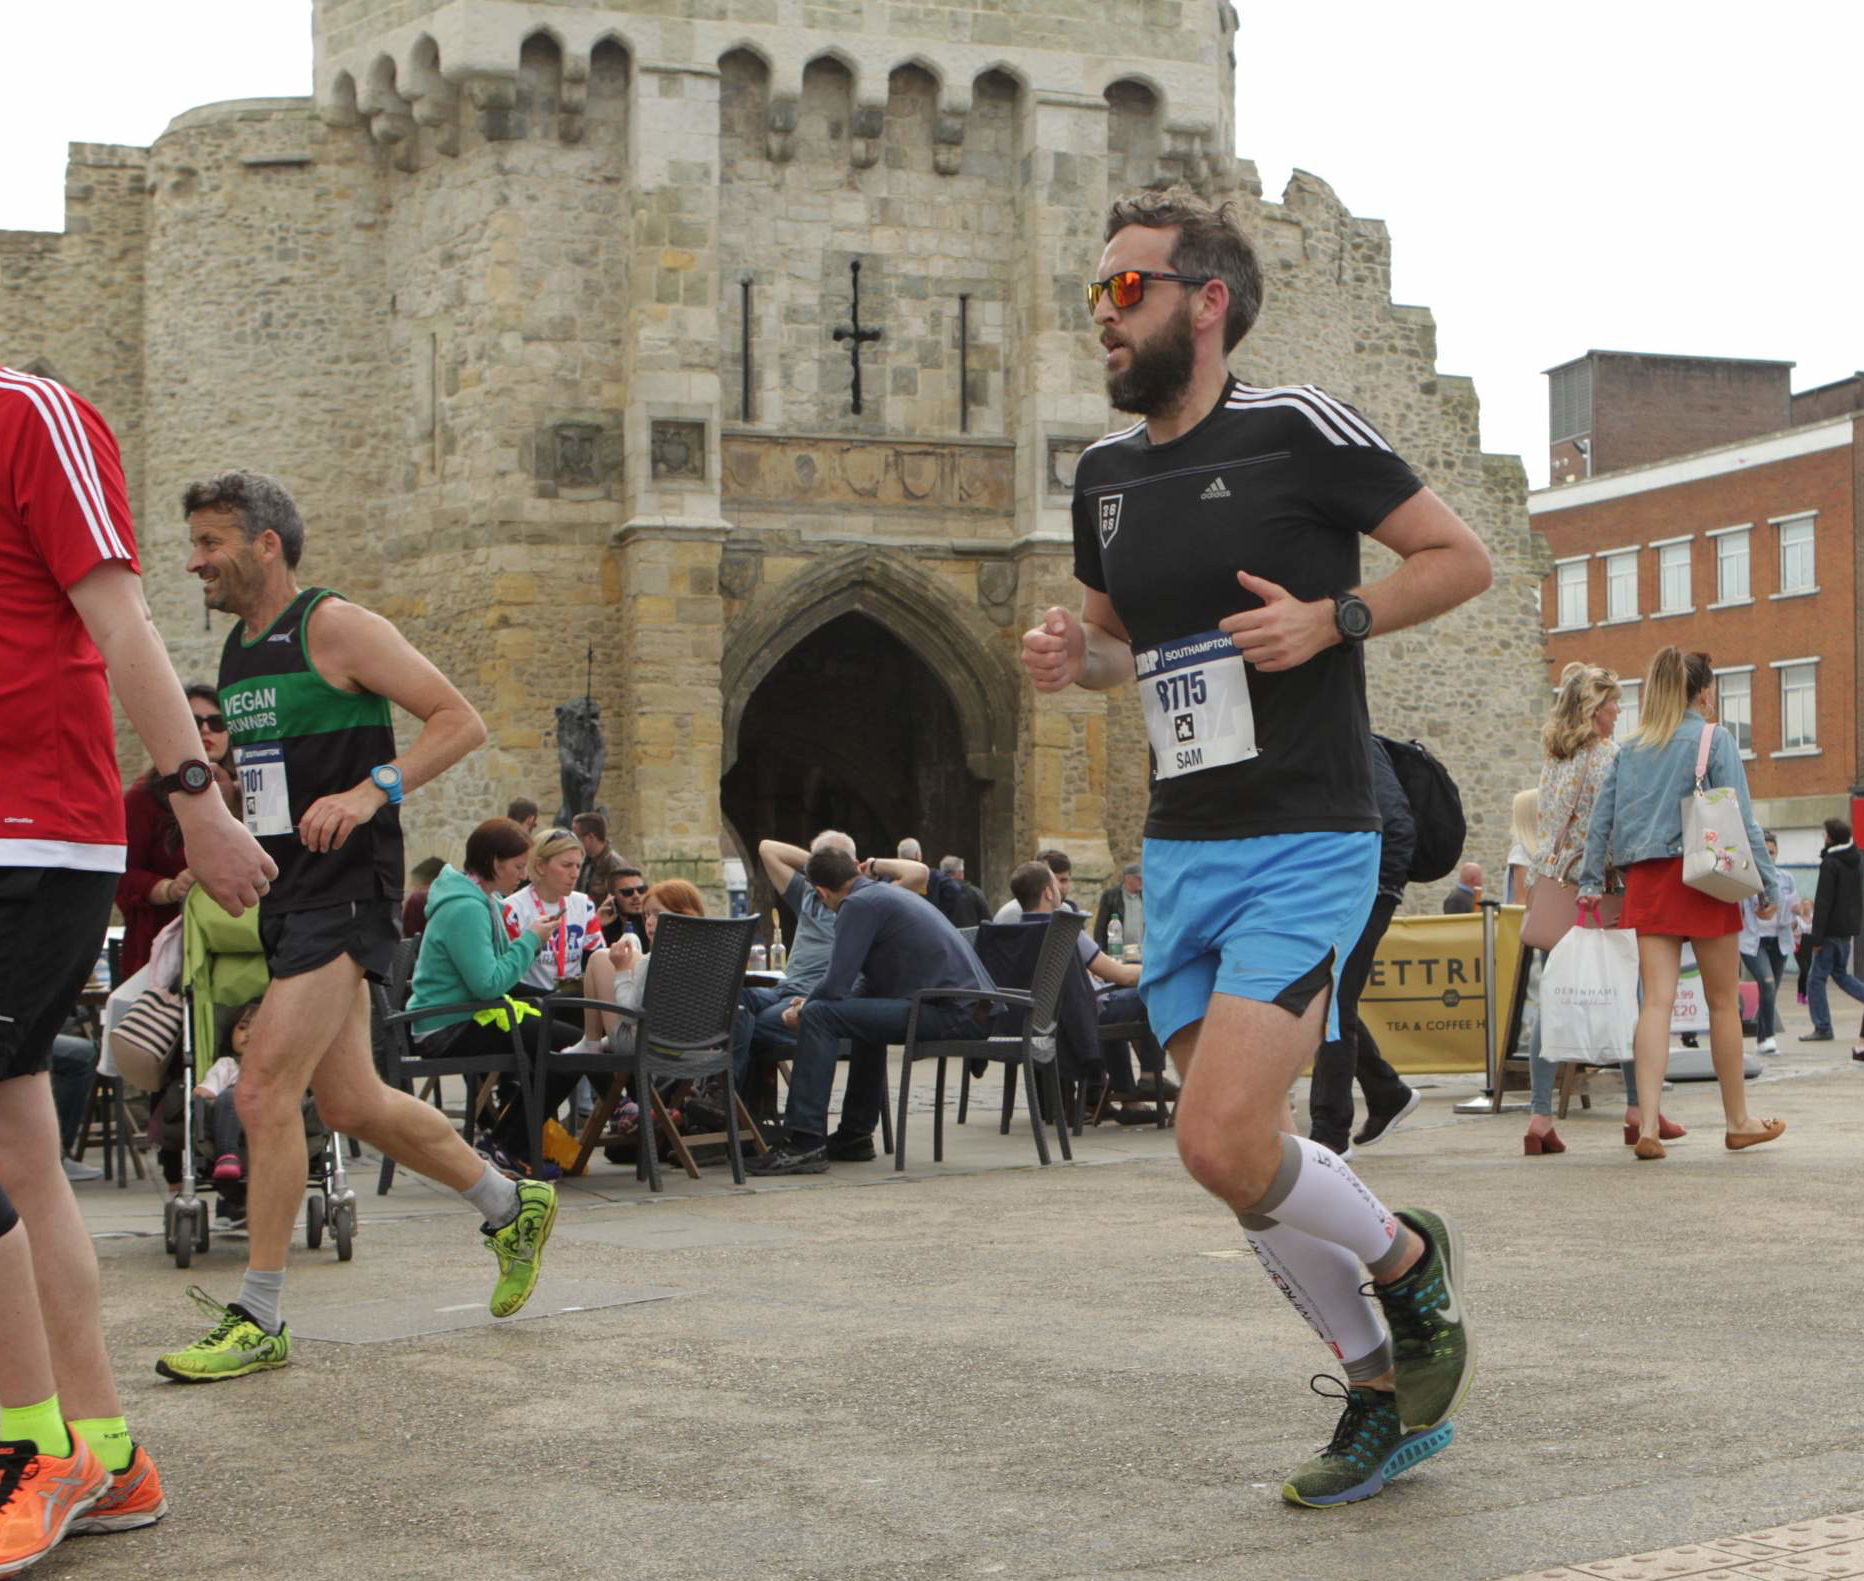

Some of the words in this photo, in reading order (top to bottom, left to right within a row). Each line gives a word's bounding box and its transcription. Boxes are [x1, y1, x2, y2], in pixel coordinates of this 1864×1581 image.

[1201, 489, 1231, 500] adidas
[1165, 637, 1233, 662] SOUTHAMPTON
[224, 687, 277, 717] VEGAN
[1156, 670, 1207, 713] 8775
[227, 711, 278, 735] RUNNERS
[1176, 747, 1204, 770] SAM
[1369, 957, 1482, 987] ETTRI
[1386, 1021, 1410, 1031] TEA
[1413, 1021, 1422, 1031] &
[1425, 1019, 1472, 1031] COFFEE
[1476, 1018, 1486, 1029] H
